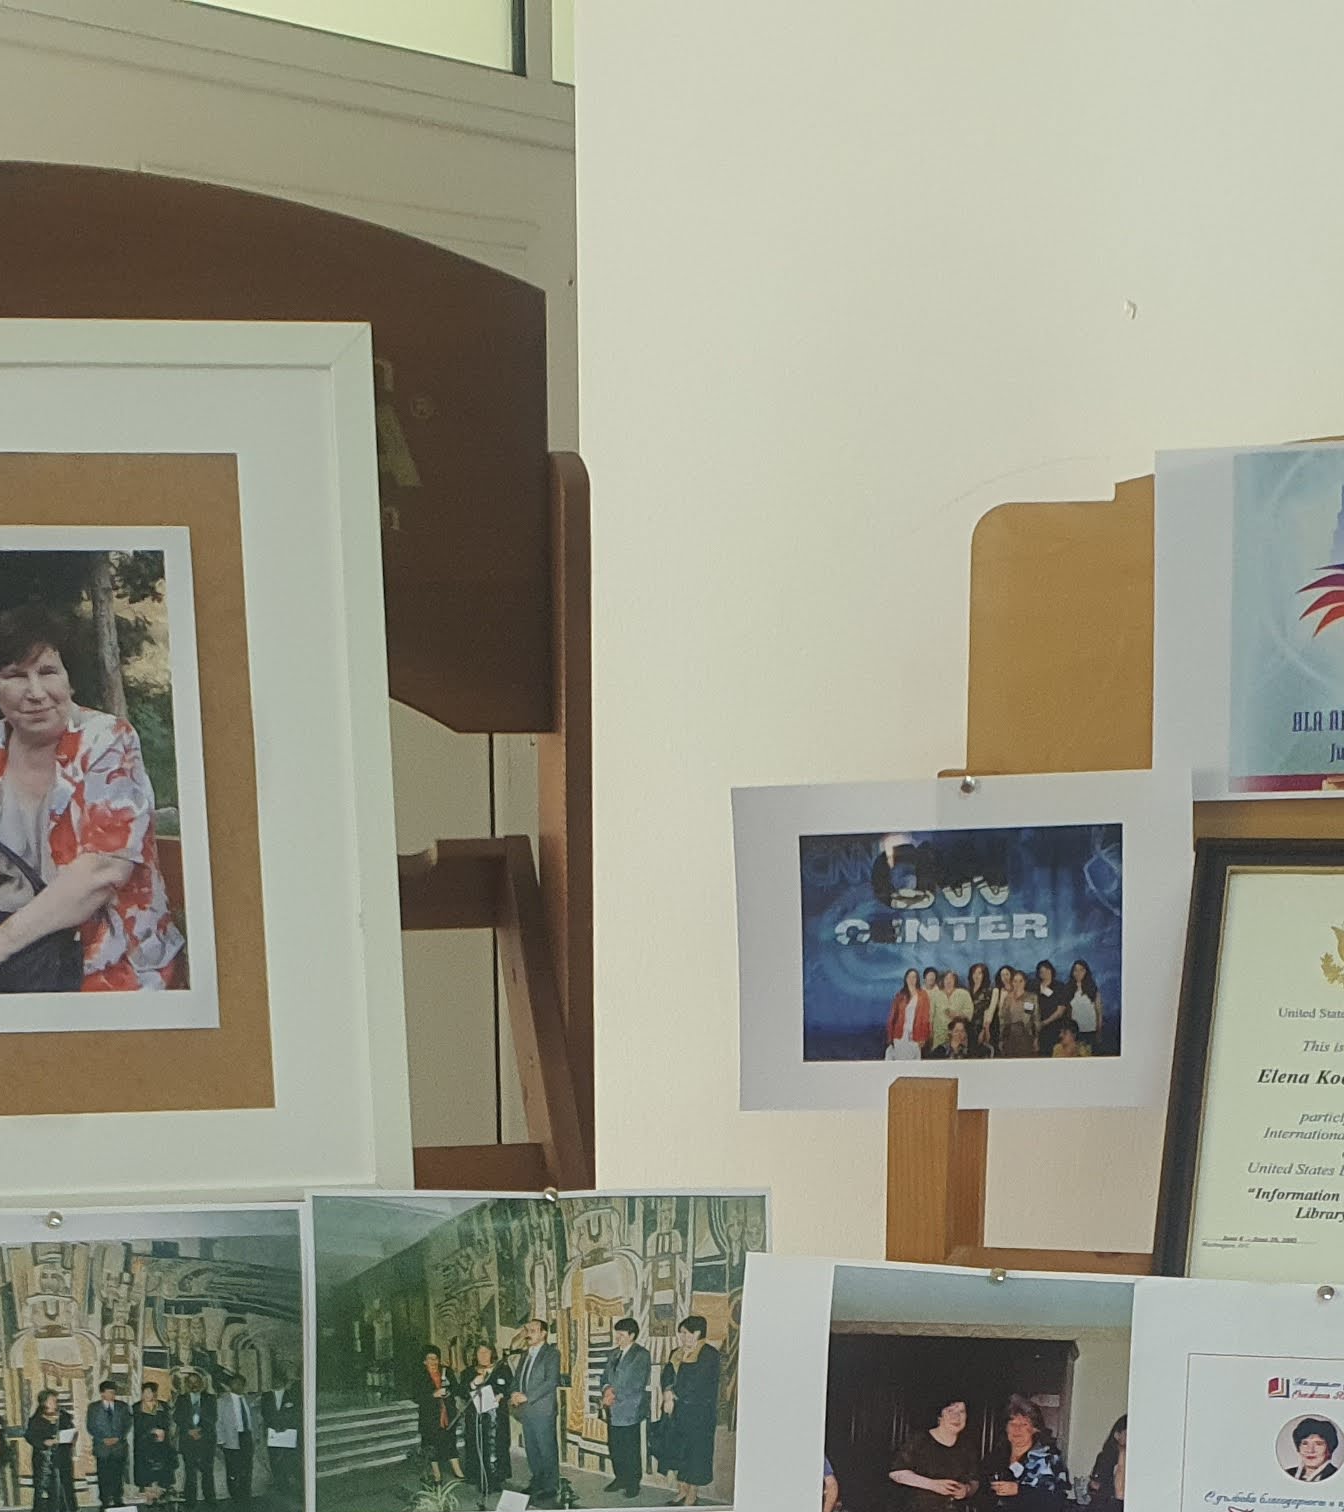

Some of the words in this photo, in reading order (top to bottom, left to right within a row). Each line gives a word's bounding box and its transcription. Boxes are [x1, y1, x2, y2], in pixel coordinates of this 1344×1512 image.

[1292, 711, 1323, 732] ALA
[834, 913, 1048, 945] CNTER
[1278, 1007, 1316, 1019] United
[1302, 1040, 1330, 1053] This
[1333, 1041, 1344, 1053] is
[1257, 1068, 1310, 1085] Elena
[1247, 1162, 1294, 1175] United
[1295, 1163, 1335, 1177] States
